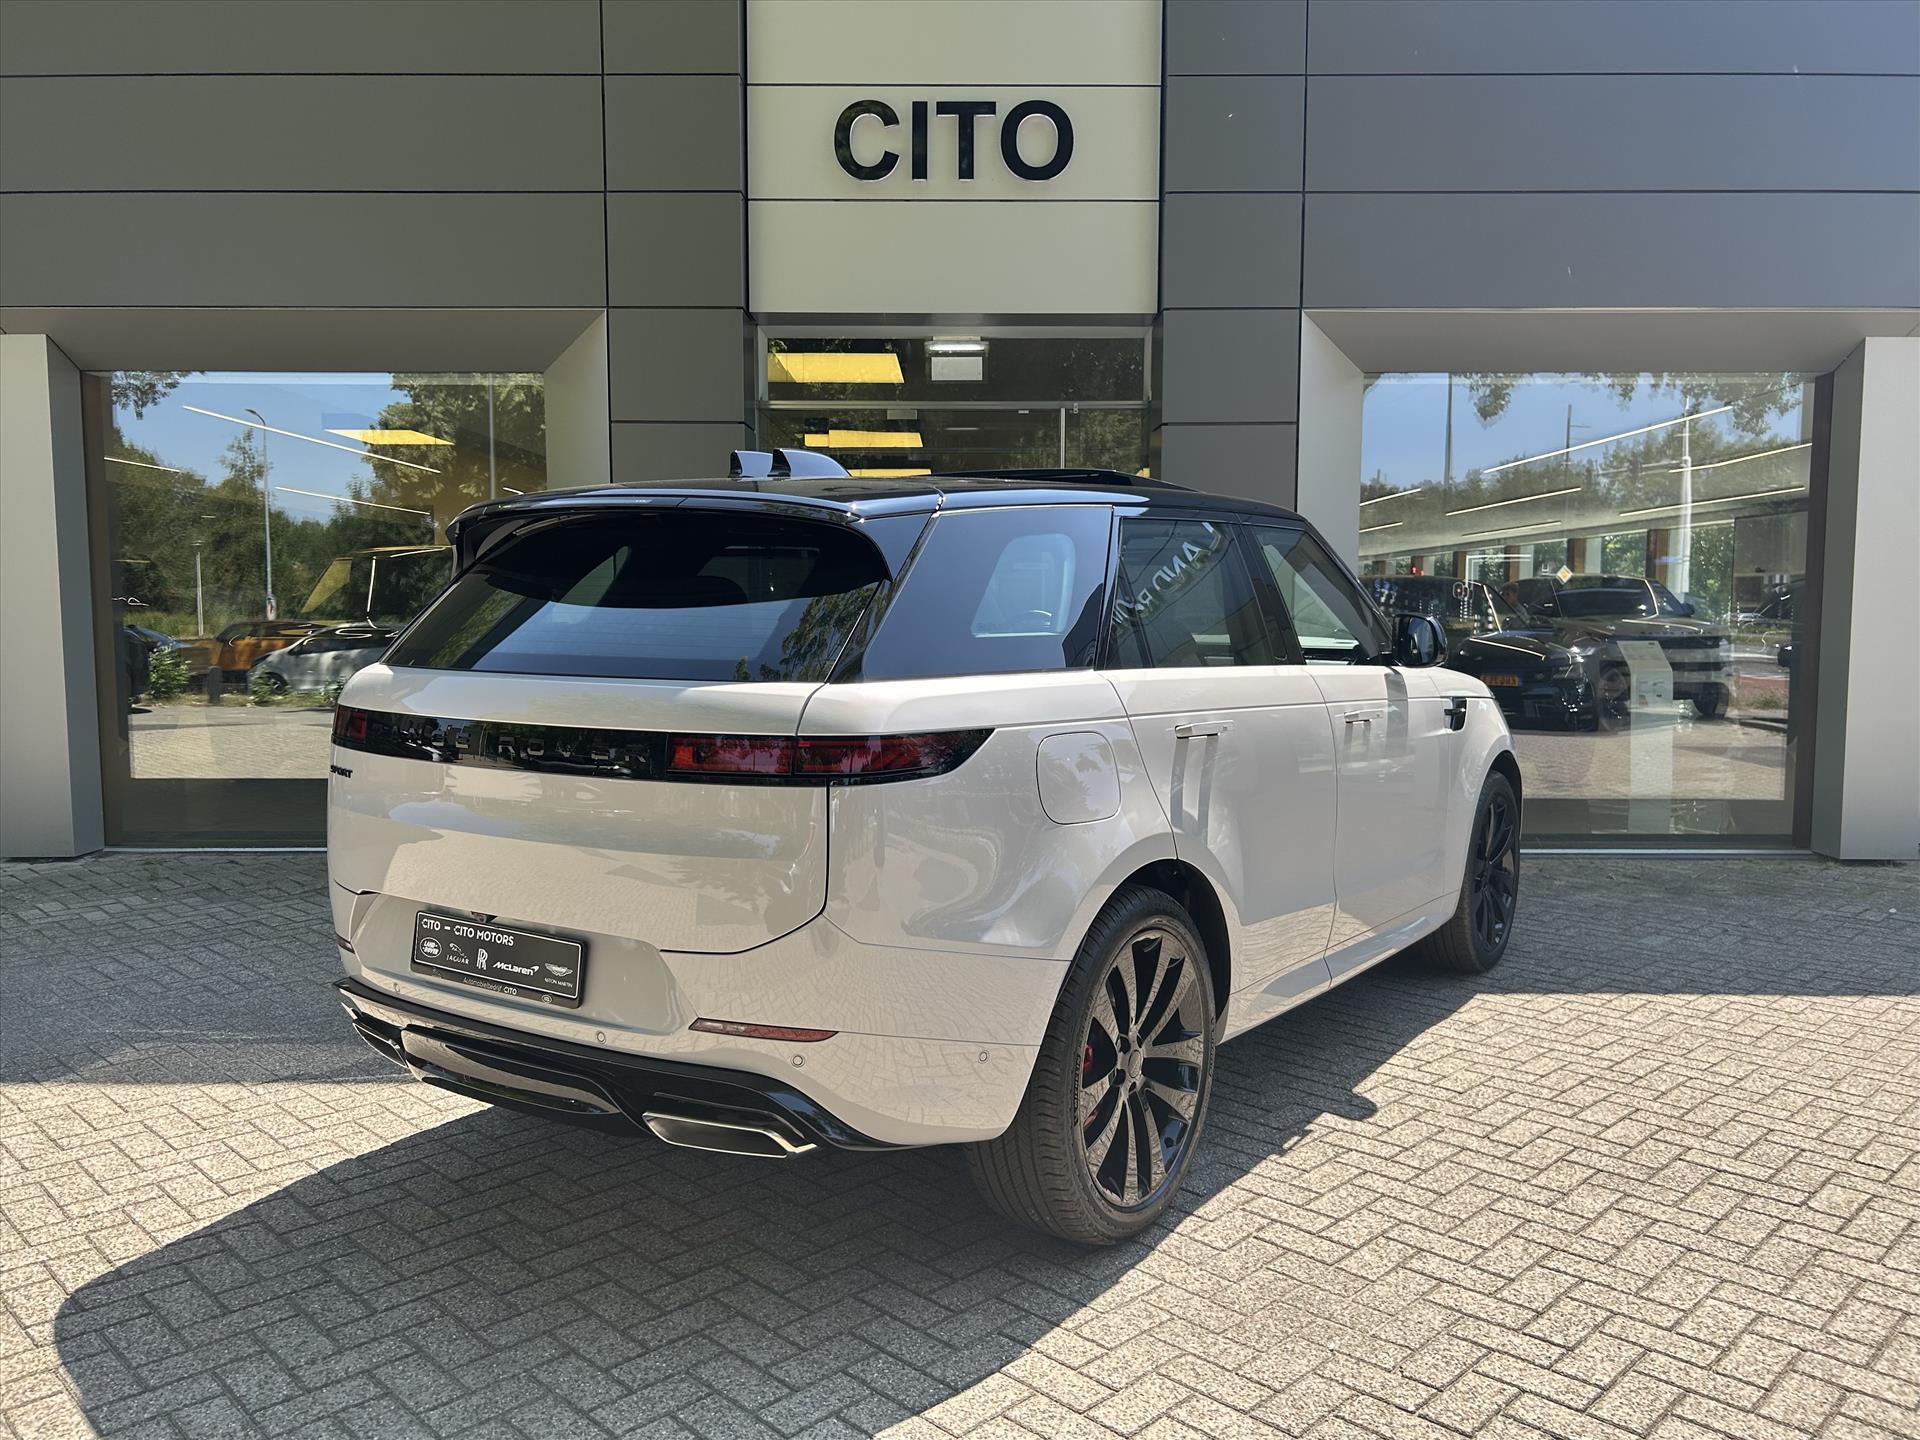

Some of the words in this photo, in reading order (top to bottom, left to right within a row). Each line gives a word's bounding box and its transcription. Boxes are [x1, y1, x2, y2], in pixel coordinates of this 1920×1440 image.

[834, 100, 1074, 182] CITO
[330, 764, 353, 779] SPORT
[421, 918, 441, 931] CITO
[453, 925, 475, 938] CITO
[476, 930, 514, 946] MOTORS
[446, 954, 470, 965] JAGUAR
[492, 961, 534, 976] McLaren
[503, 986, 518, 996] CITO
